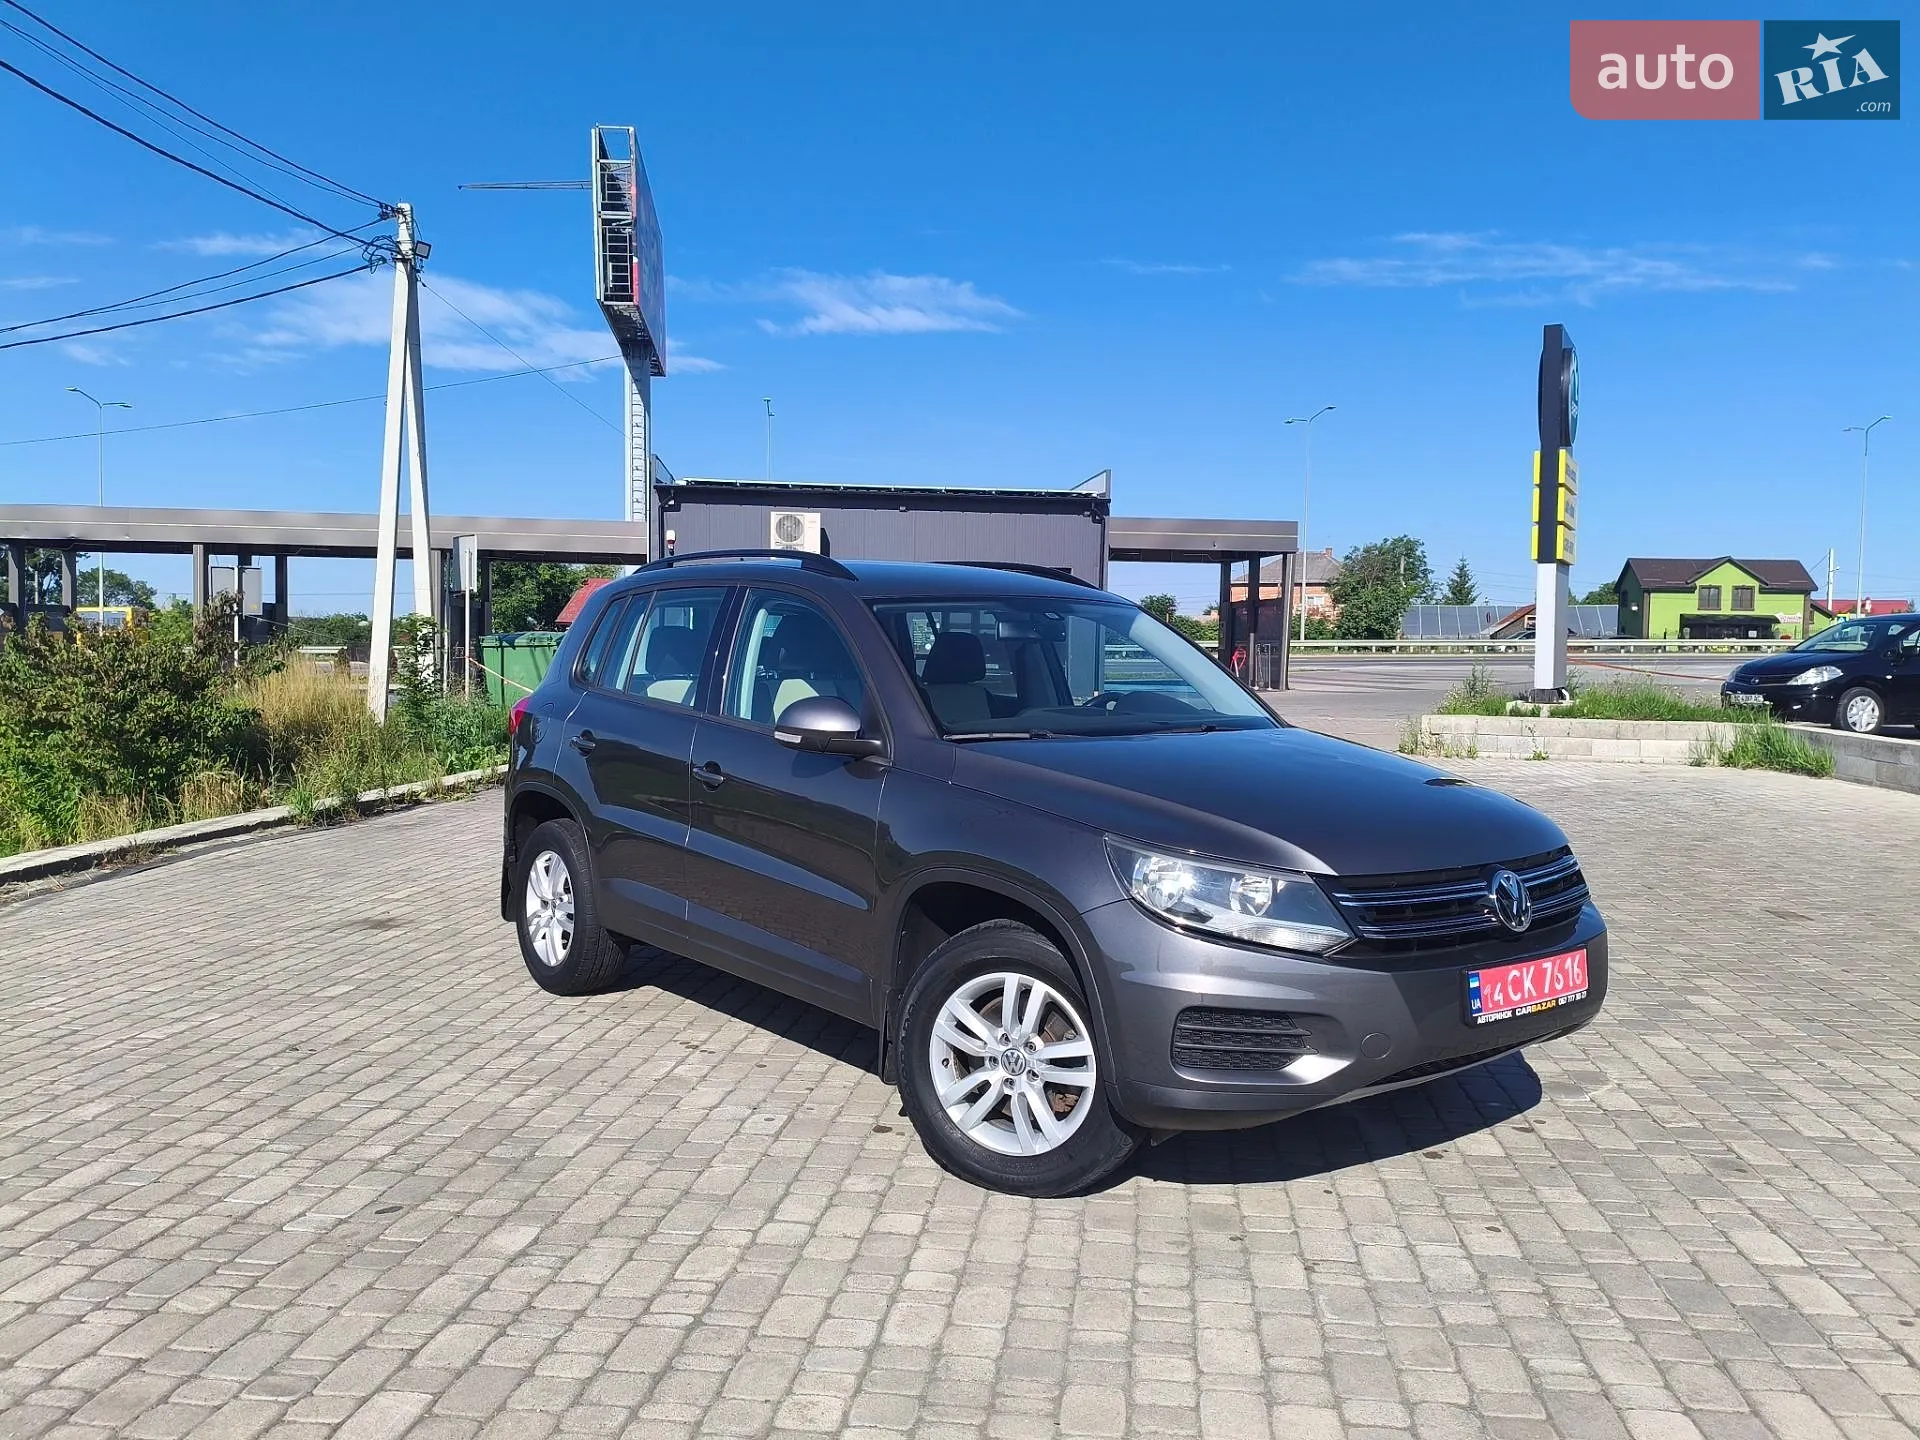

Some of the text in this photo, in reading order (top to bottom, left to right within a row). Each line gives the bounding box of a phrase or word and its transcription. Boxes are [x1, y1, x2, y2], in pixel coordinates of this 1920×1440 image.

[1483, 954, 1583, 1008] 14 CK 7616
[1471, 998, 1482, 1010] UA
